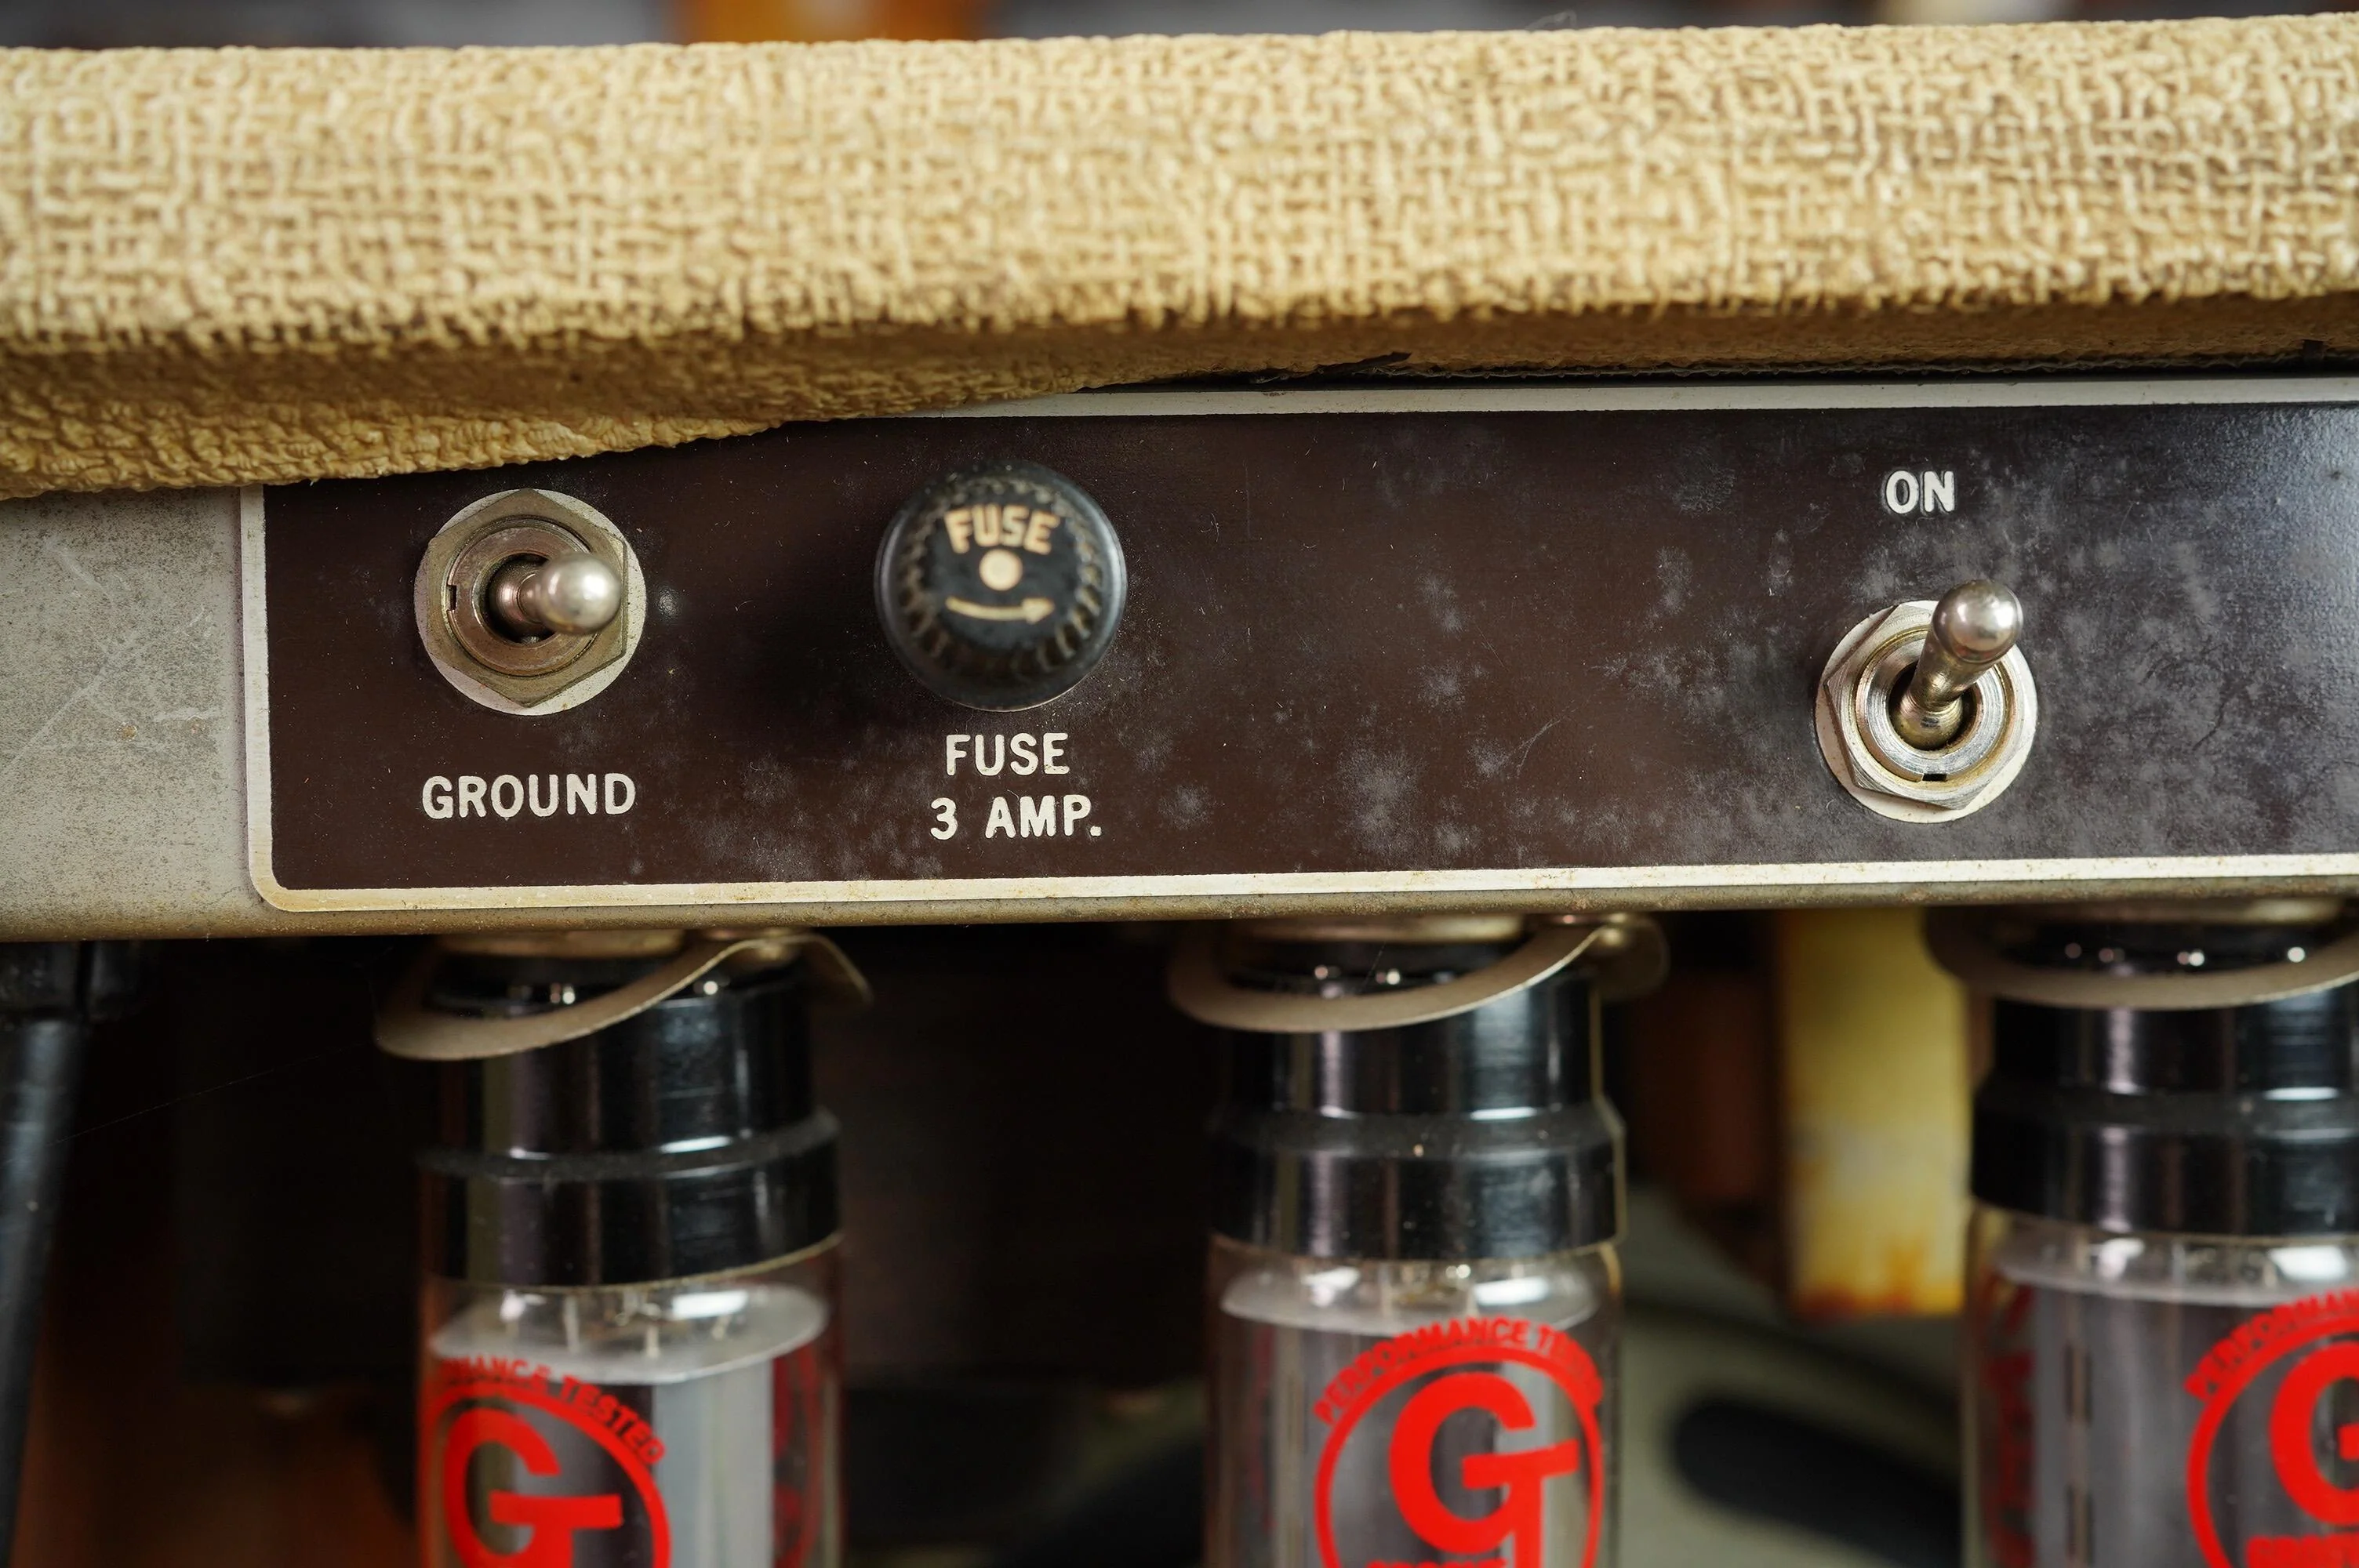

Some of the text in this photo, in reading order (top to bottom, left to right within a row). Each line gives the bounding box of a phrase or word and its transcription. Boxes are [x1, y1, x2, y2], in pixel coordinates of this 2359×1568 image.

[1886, 470, 1955, 514] ON
[943, 504, 1060, 554] FUSE
[945, 732, 1070, 776] FUSE
[422, 773, 636, 818] GROUND
[930, 795, 1102, 840] 3 AMP.
[1313, 1316, 1528, 1425] PERFORMANCE
[560, 1374, 666, 1465] TESTED
